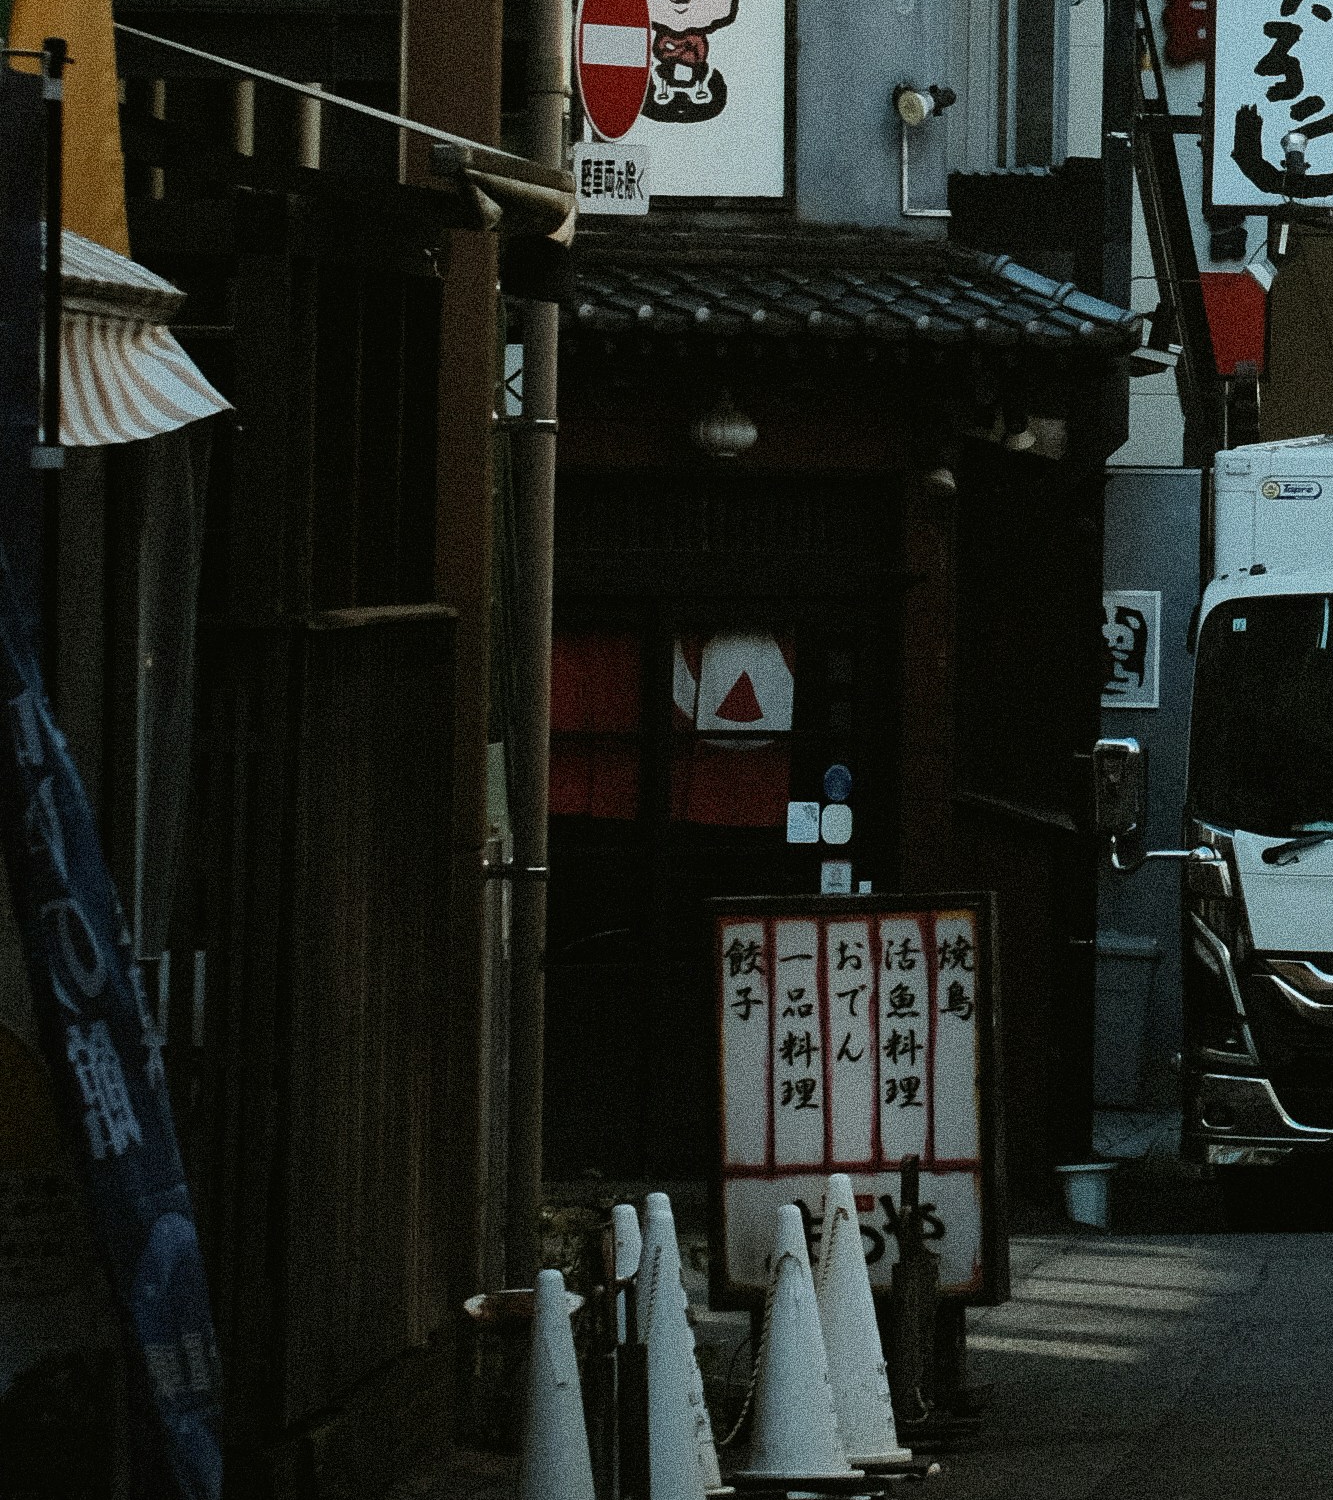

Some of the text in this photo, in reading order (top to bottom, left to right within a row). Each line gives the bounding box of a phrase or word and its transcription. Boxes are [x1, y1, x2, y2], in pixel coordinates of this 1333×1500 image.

[777, 949, 820, 1112] 一品料理
[835, 939, 867, 1065] おでん
[883, 938, 925, 1110] 活魚料理
[935, 935, 976, 1021] 焼鳥
